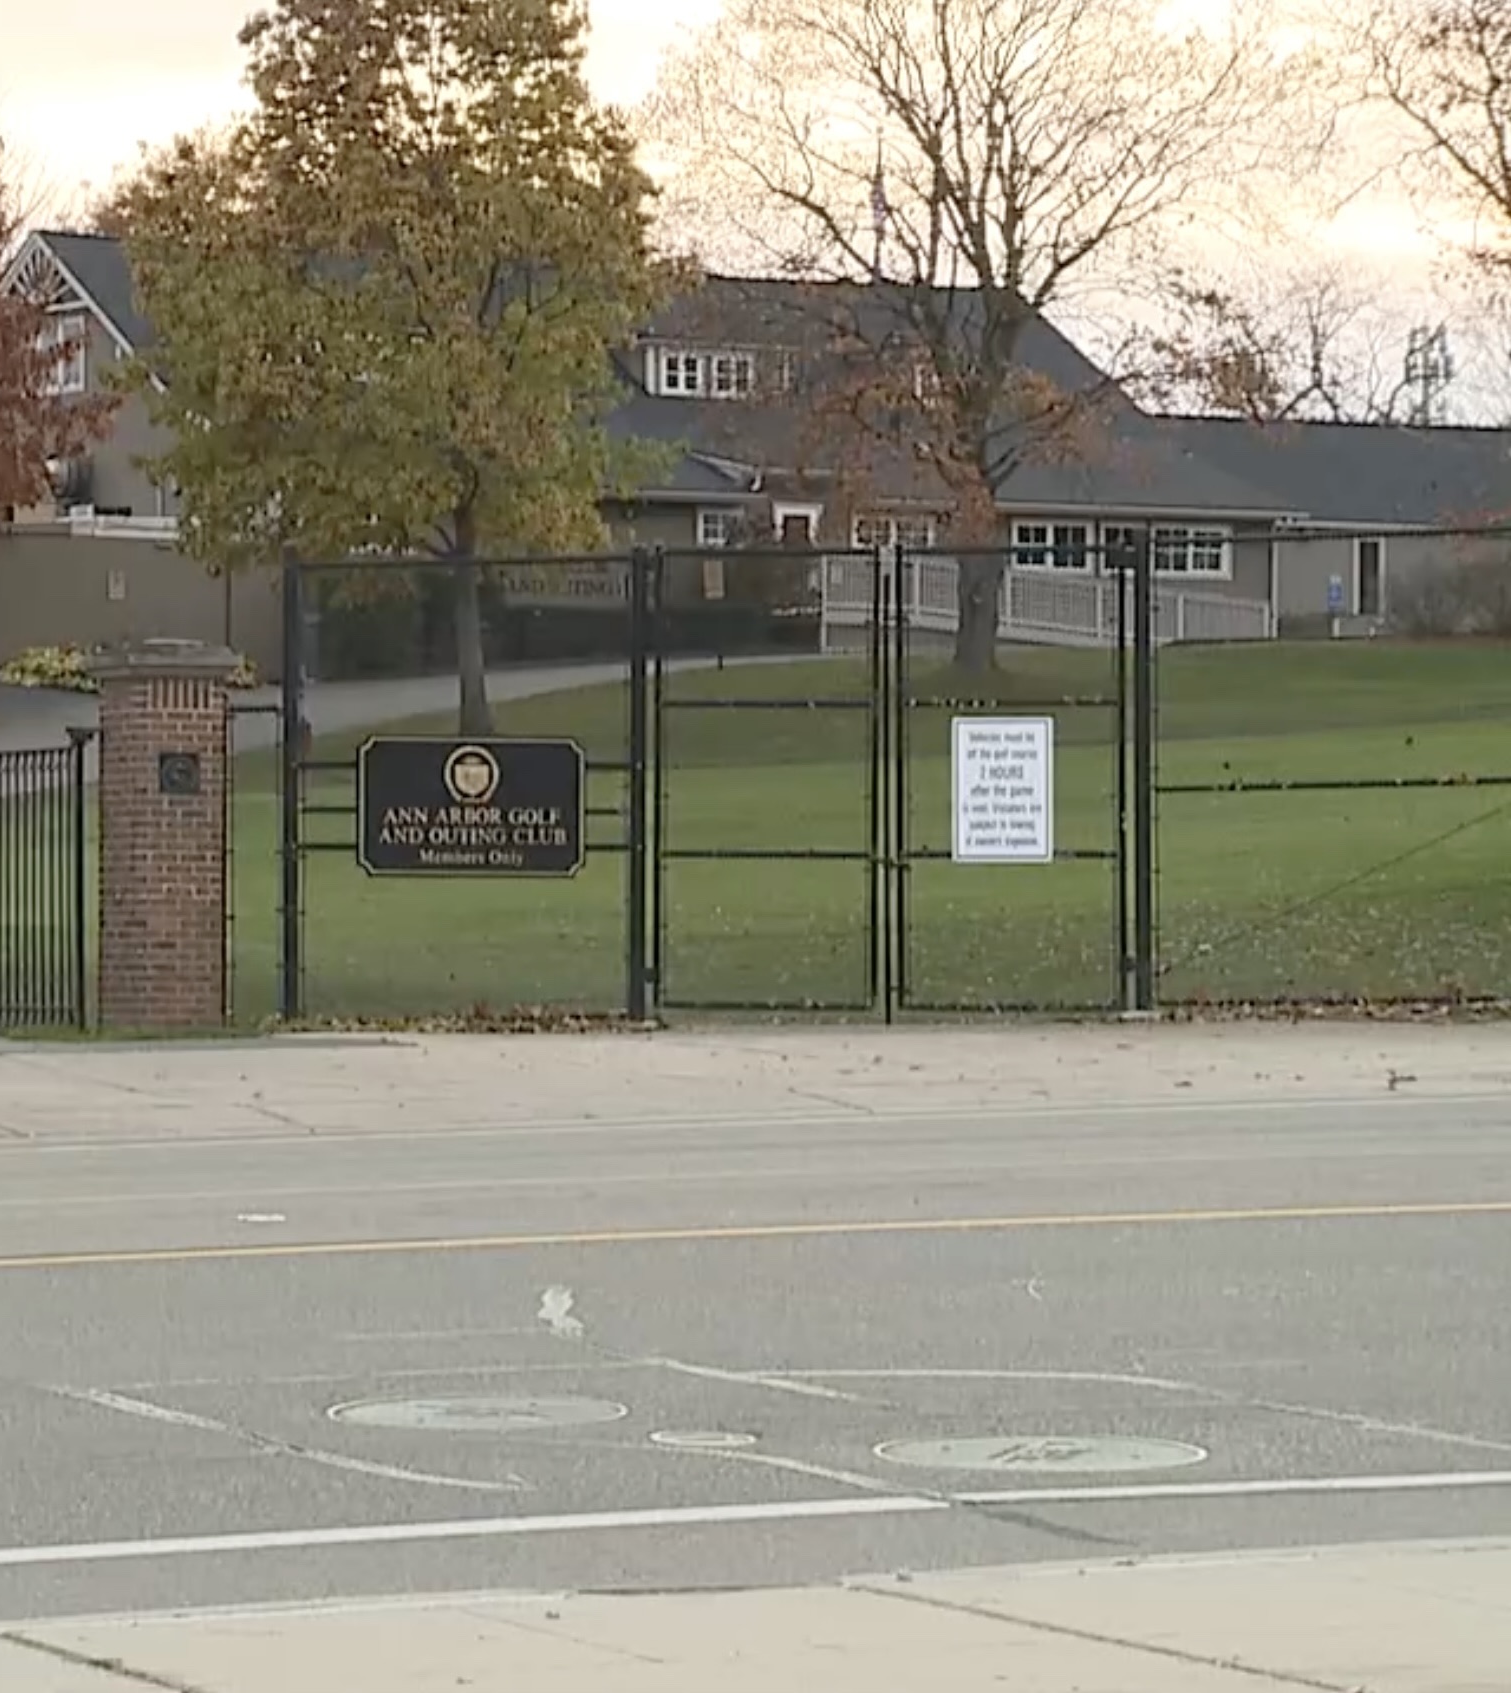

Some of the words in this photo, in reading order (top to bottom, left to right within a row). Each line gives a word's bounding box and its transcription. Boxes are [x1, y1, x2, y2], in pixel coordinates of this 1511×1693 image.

[989, 764, 1023, 780] HOURS
[970, 784, 990, 798] after
[994, 784, 1006, 798] the
[1010, 784, 1034, 798] game
[383, 807, 428, 825] ANN
[434, 807, 502, 825] ARBOR
[508, 807, 560, 825] GOLF
[379, 827, 424, 845] AND
[428, 827, 506, 845] OUTING
[513, 827, 567, 845] CLUB
[419, 849, 485, 865] Members
[489, 849, 523, 865] Only
